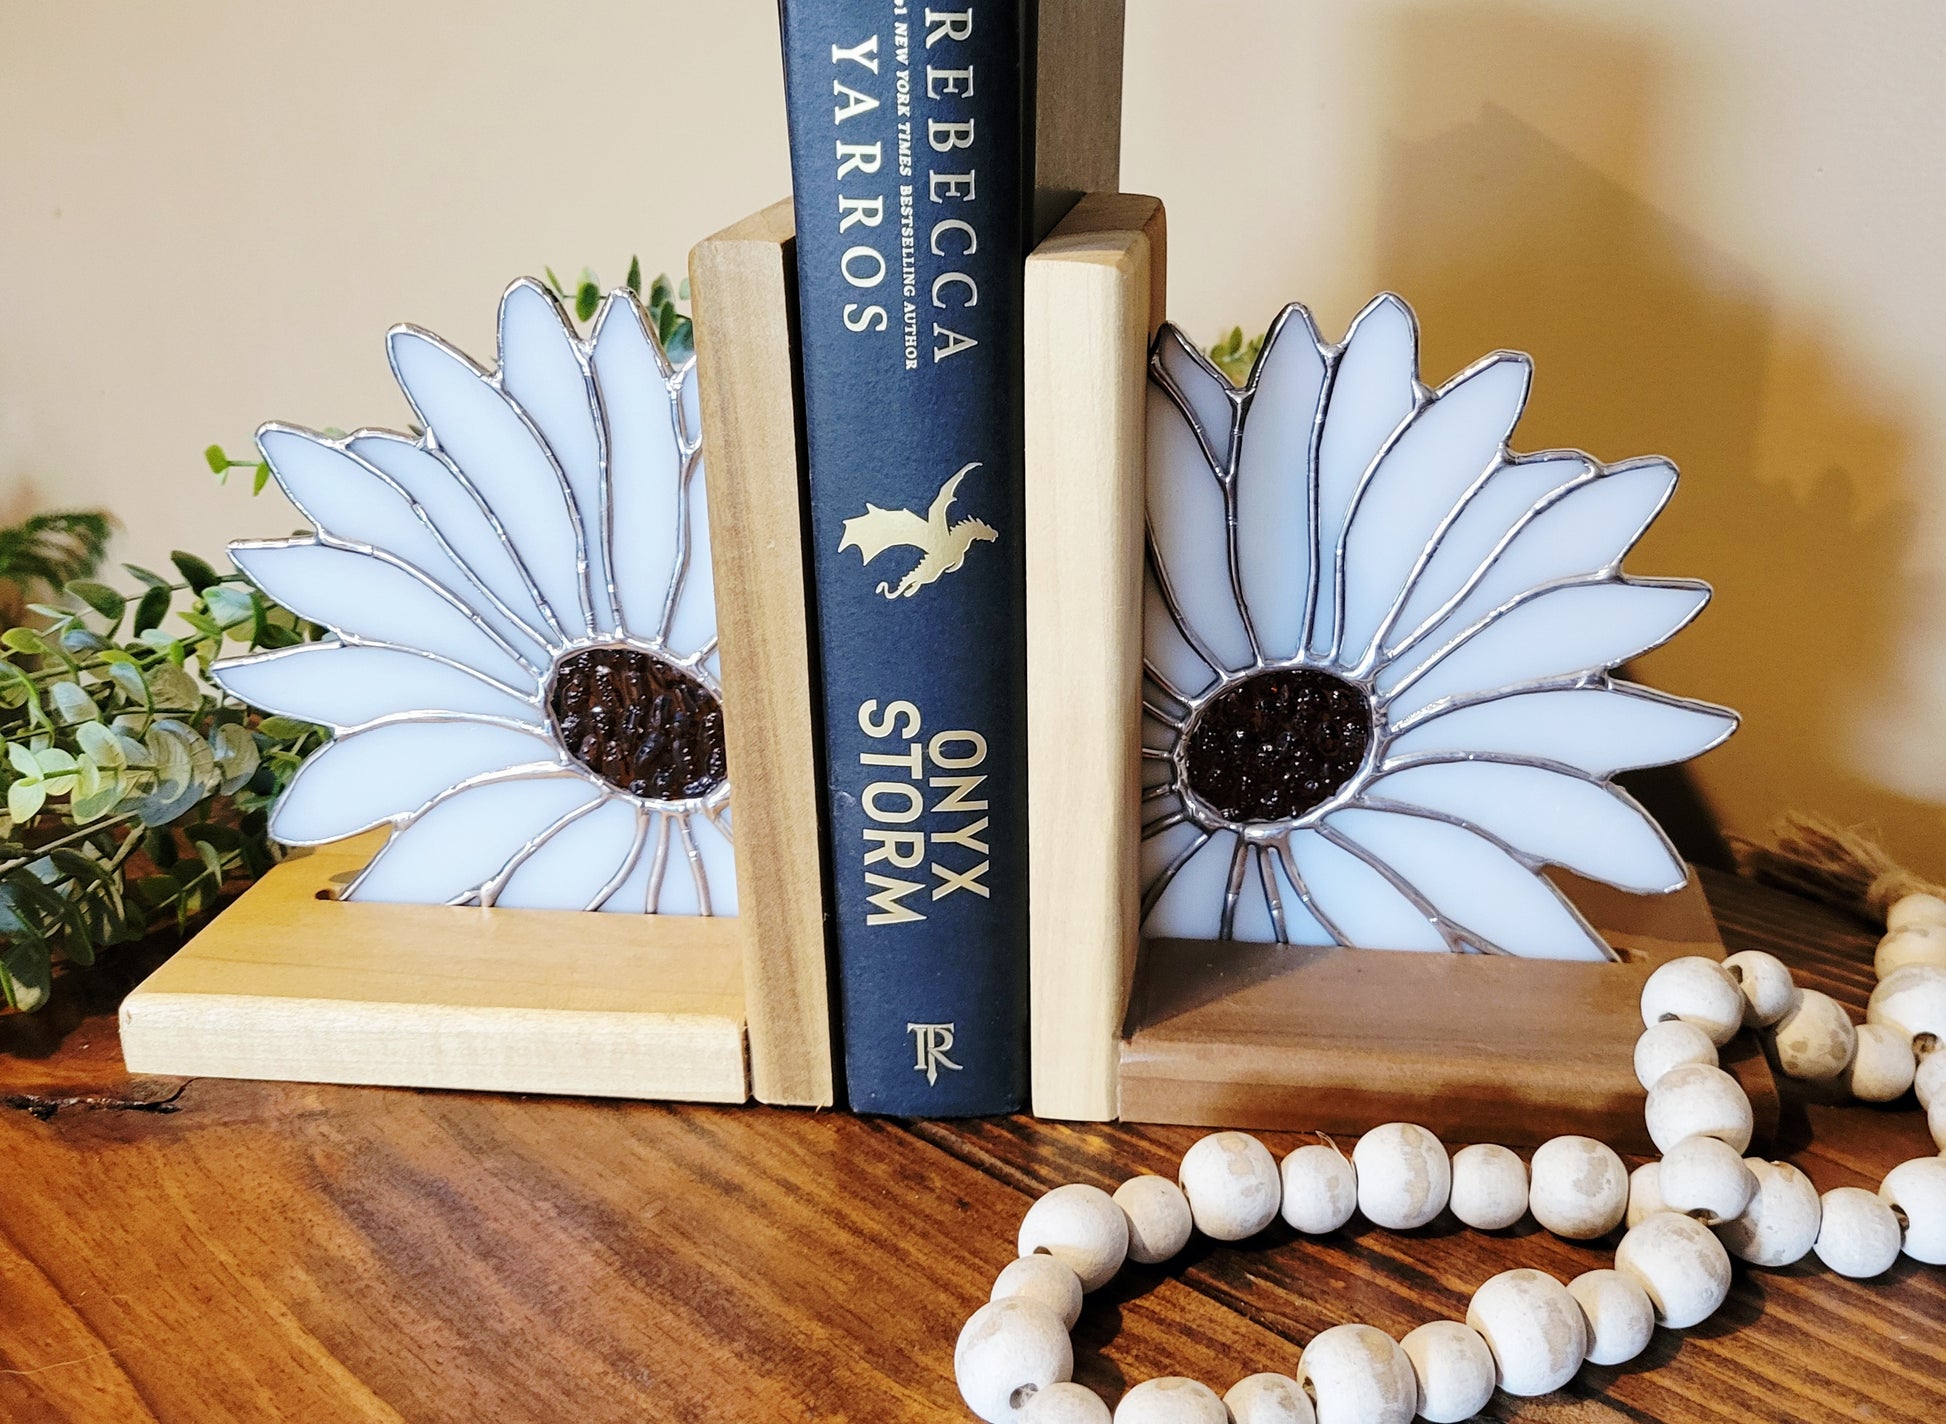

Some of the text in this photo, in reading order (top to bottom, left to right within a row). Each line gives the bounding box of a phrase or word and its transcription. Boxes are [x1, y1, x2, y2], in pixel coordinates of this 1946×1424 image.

[894, 22, 909, 66] NEW
[896, 70, 910, 117] YORK
[832, 34, 888, 332] YARROS
[898, 122, 912, 176] TIMES
[925, 7, 978, 363] REBECCA
[900, 185, 915, 297] BESTSELLING
[904, 301, 917, 370] AUTHOR
[858, 699, 927, 926] STORM
[928, 730, 990, 901] ONYX
